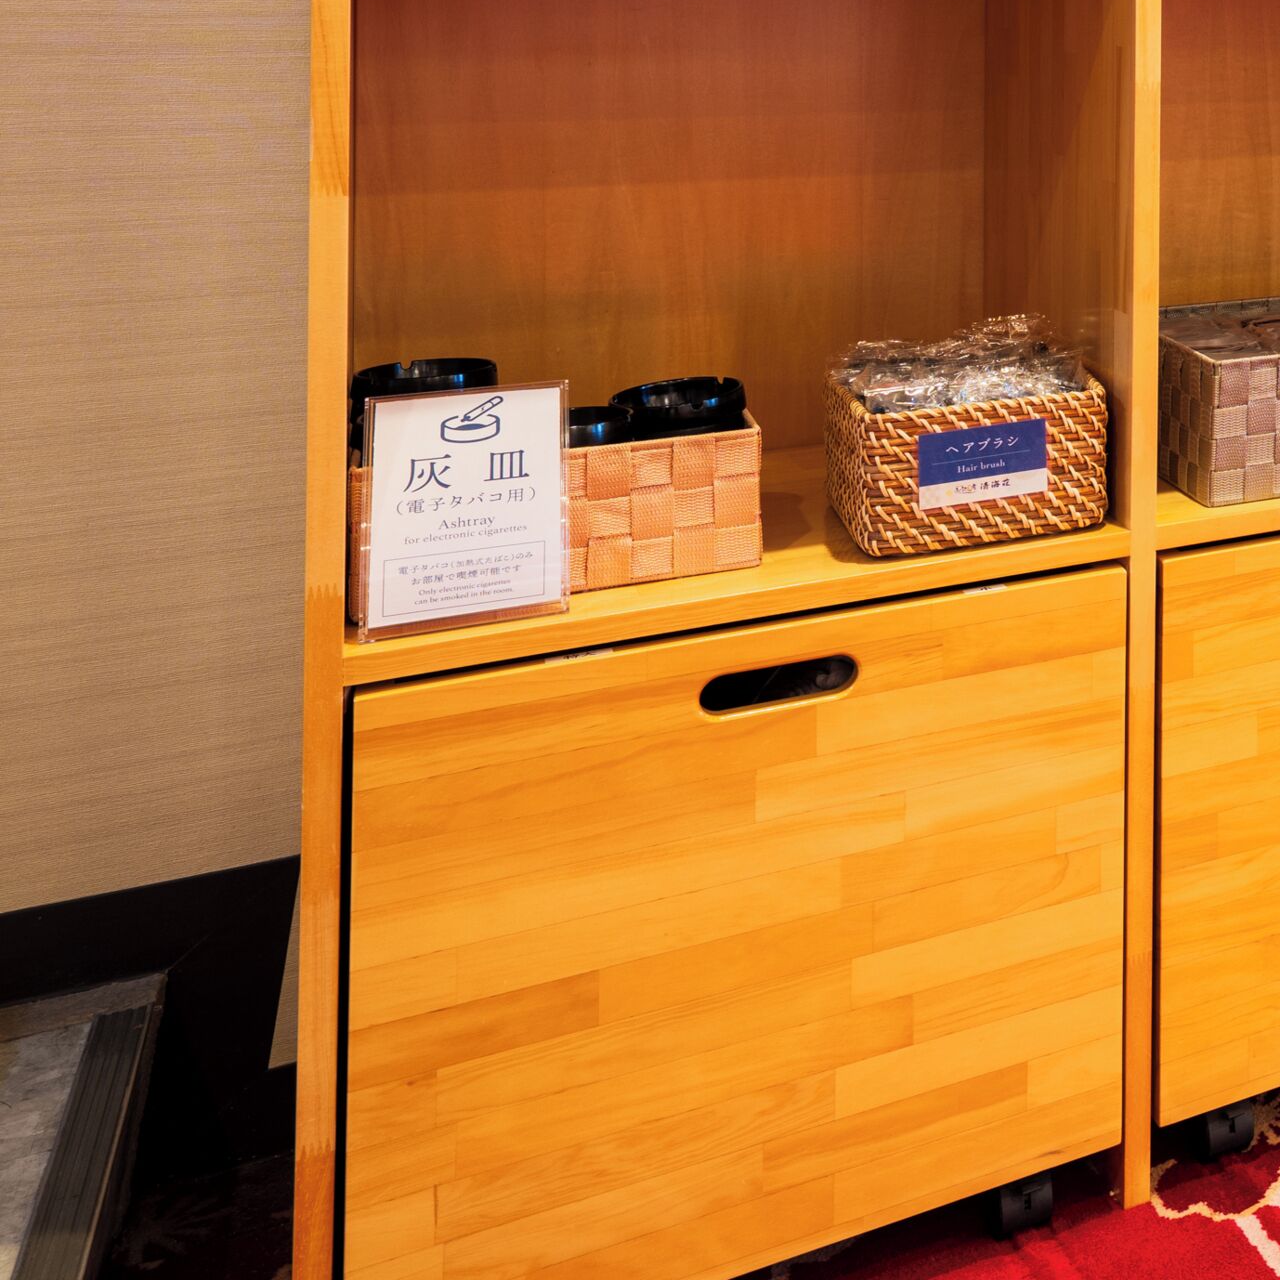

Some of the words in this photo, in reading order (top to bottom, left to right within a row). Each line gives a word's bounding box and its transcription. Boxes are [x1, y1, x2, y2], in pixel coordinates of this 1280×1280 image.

[945, 436, 1019, 454] ヘアブラシ
[957, 463, 978, 474] Hair
[980, 459, 1006, 470] brush
[438, 515, 496, 530] Ashtray
[404, 536, 420, 545] for
[422, 530, 475, 543] electronic
[478, 524, 528, 537] cigarettes
[411, 564, 521, 586] お部屋で喫煙可能です
[418, 587, 437, 597] Only
[438, 583, 475, 594] electronic
[440, 592, 469, 602] smoked
[479, 589, 491, 597] the
